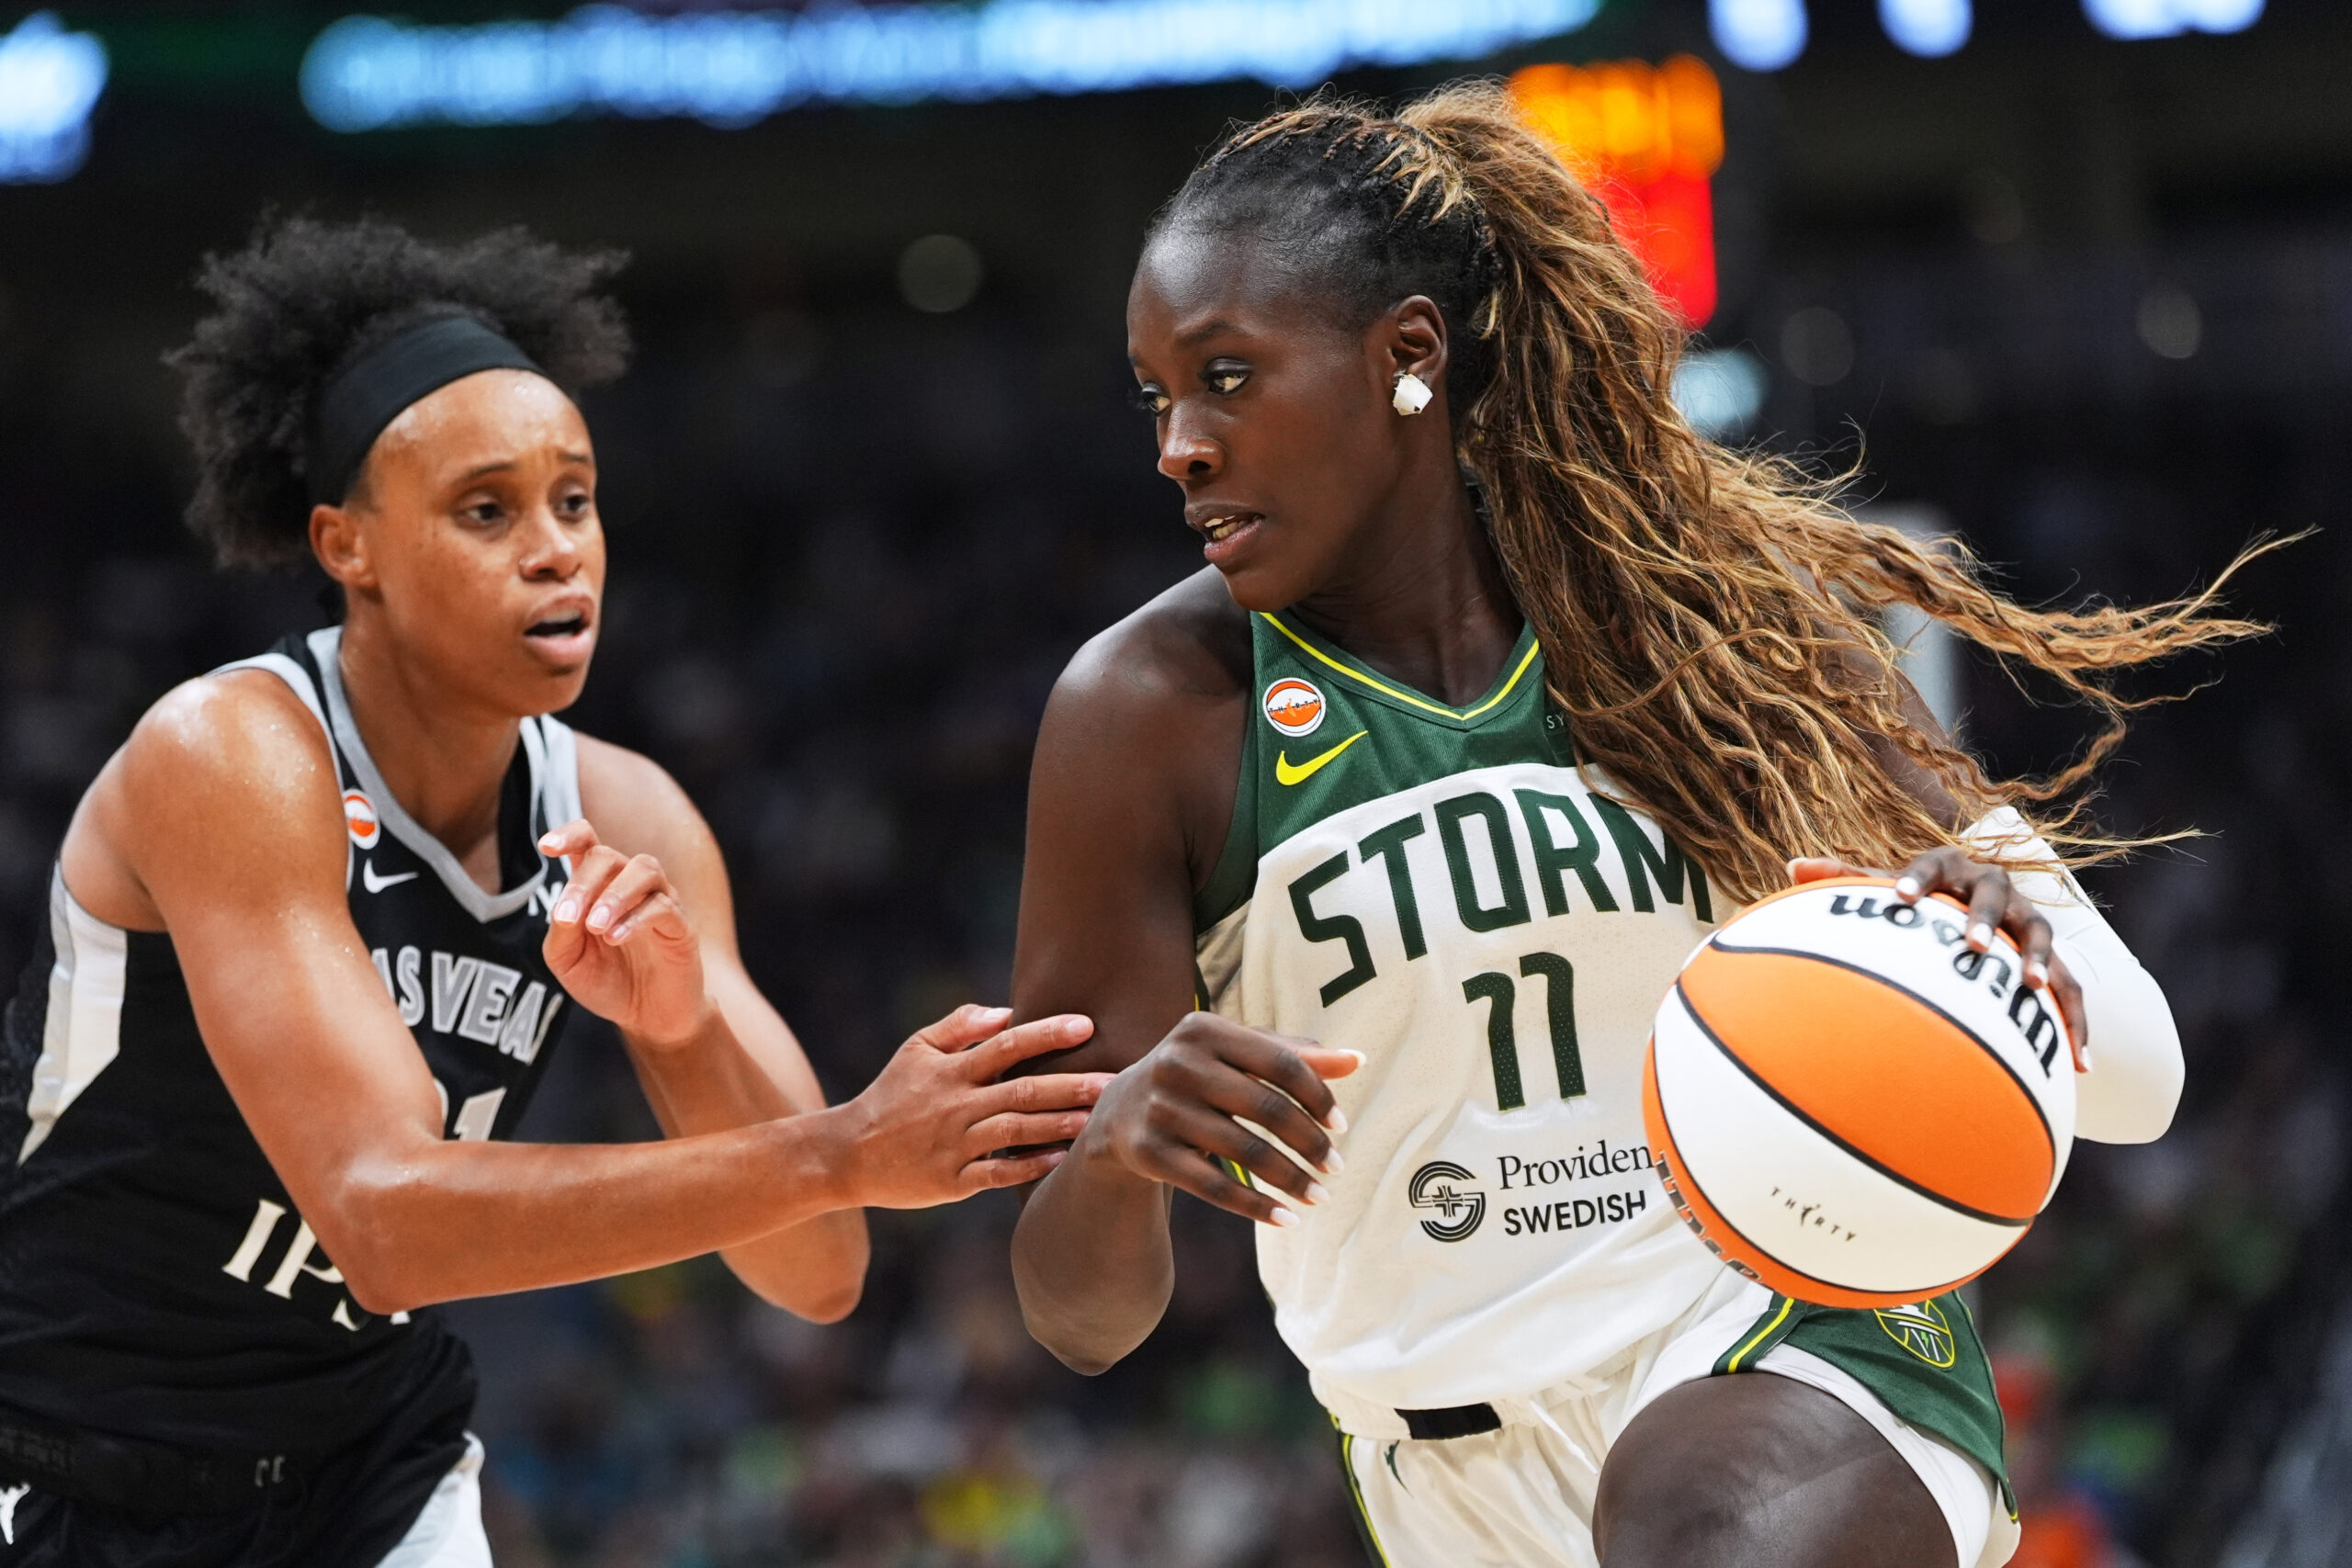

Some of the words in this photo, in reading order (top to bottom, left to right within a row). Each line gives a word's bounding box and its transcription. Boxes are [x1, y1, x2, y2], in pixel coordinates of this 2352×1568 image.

[1288, 788, 1715, 1009] STORM
[1462, 952, 1587, 1111] 11
[1829, 894, 2060, 1079] Wilson
[1497, 1139, 1655, 1190] Providen
[1504, 1190, 1646, 1236] SWEDISH
